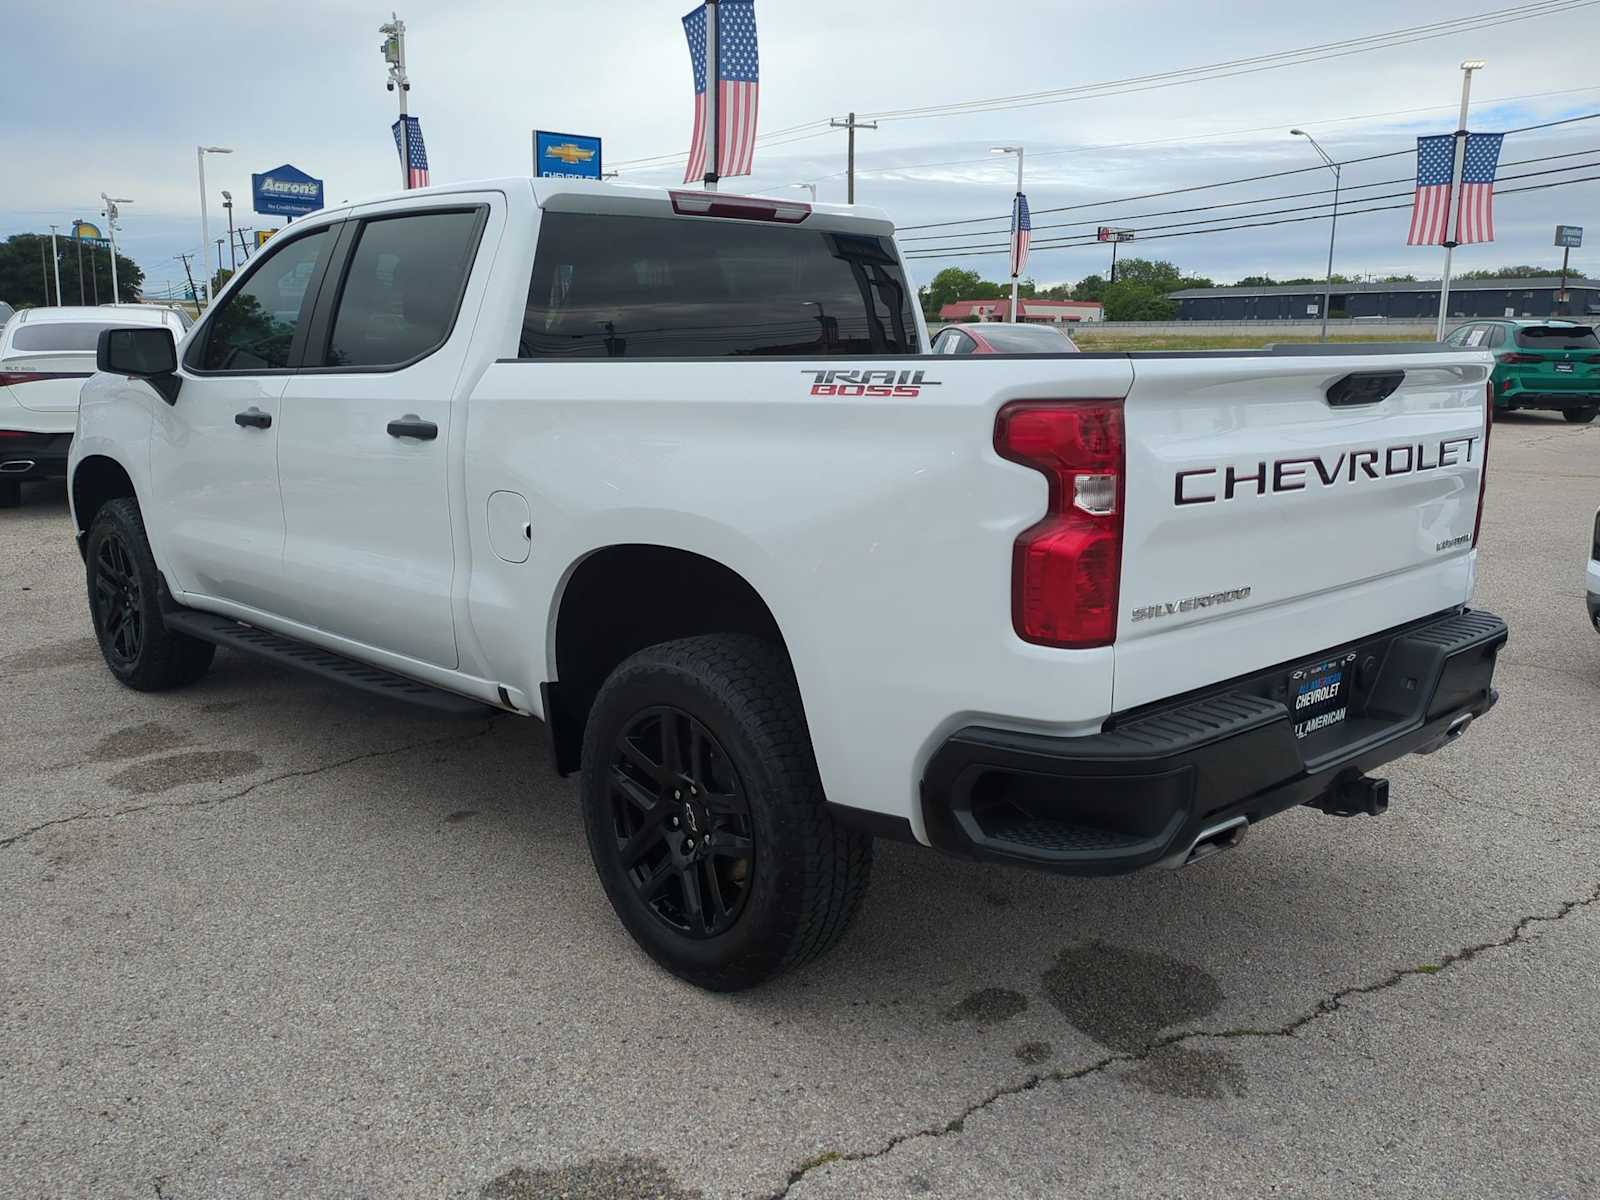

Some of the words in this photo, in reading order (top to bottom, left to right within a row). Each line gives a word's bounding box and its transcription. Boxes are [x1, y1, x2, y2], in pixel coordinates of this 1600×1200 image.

[261, 178, 318, 194] Aaron's
[801, 370, 942, 385] TRAIL
[810, 384, 920, 397] BOSS
[1174, 436, 1479, 505] CHEVROLET
[1131, 586, 1251, 621] SILVERADO
[1296, 682, 1341, 709] CHEVROLET
